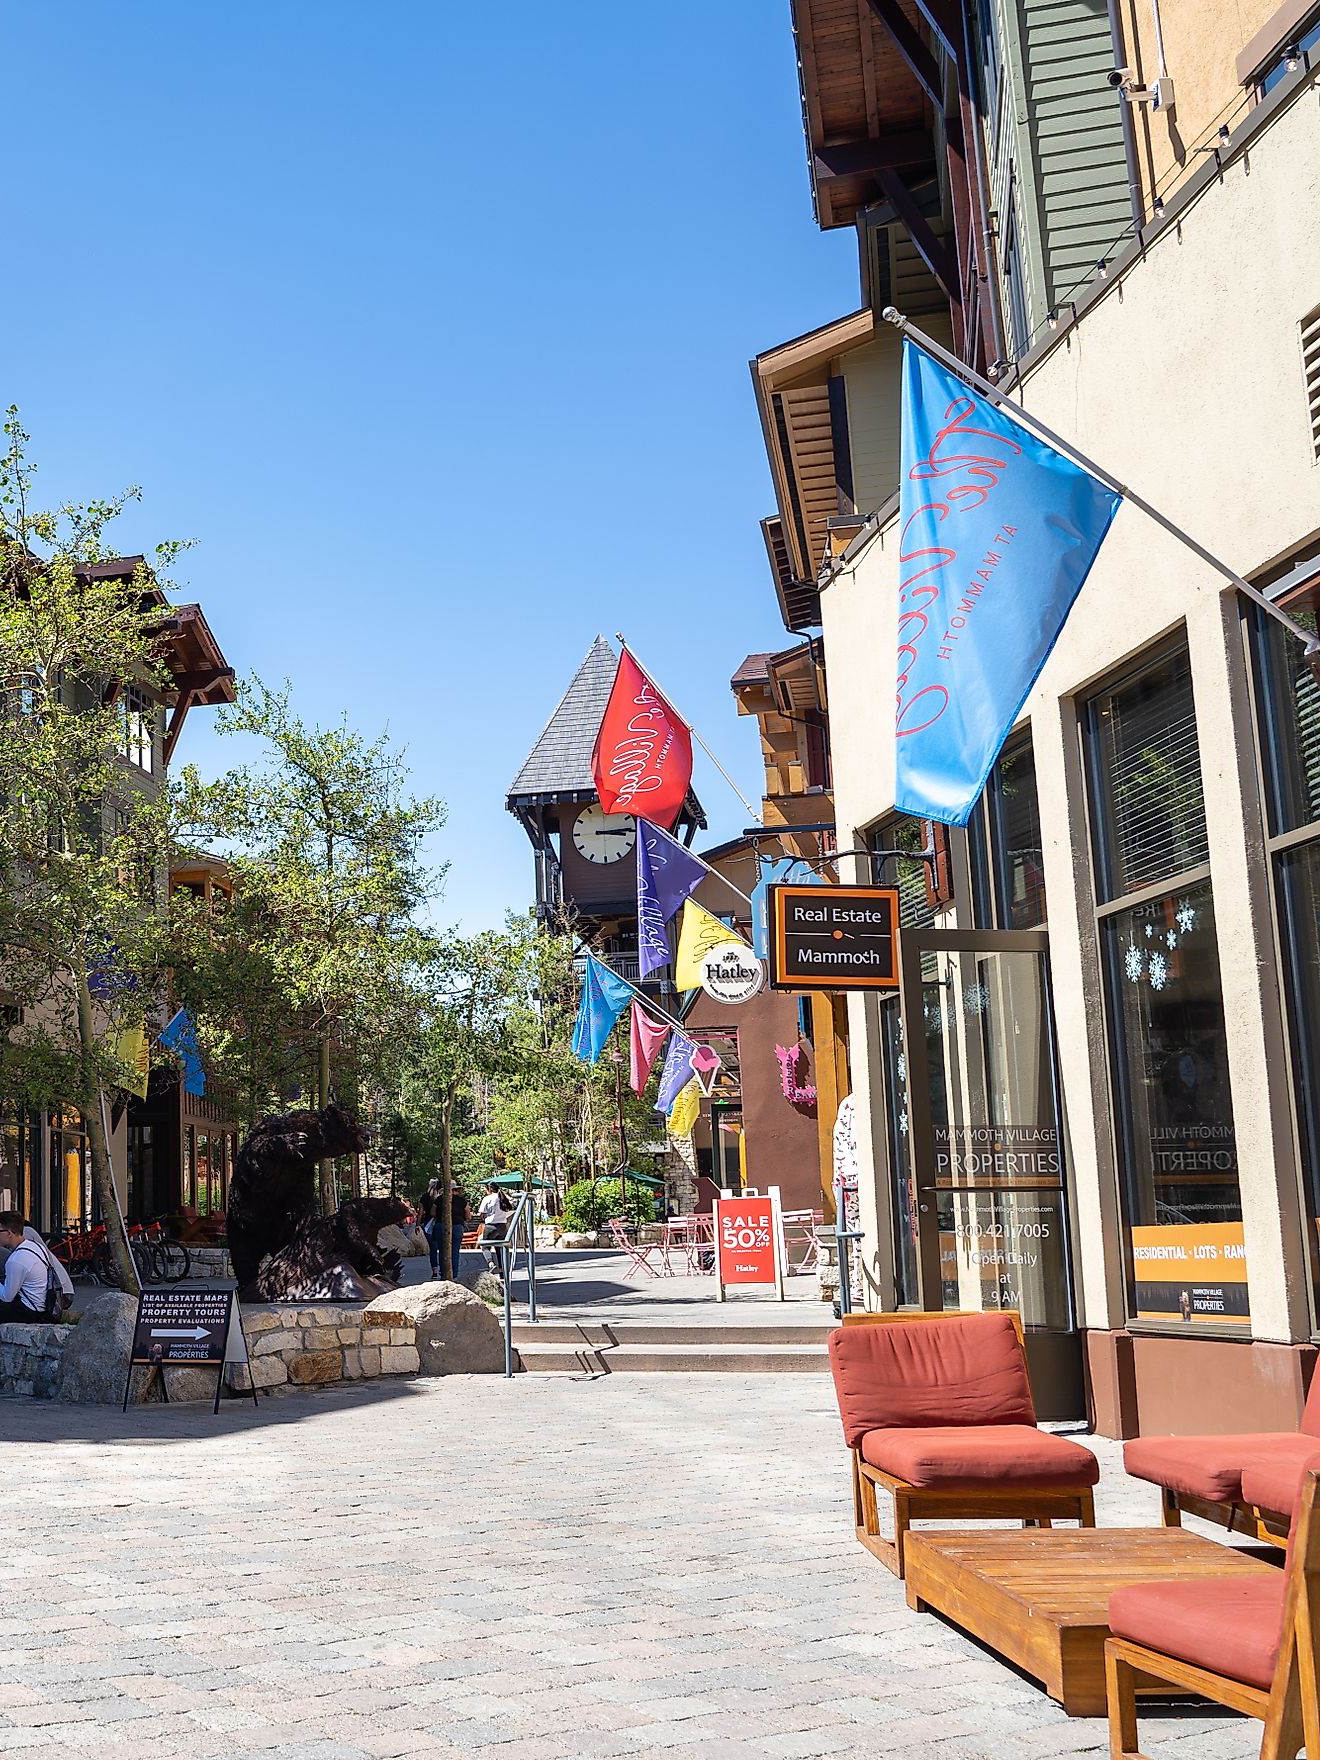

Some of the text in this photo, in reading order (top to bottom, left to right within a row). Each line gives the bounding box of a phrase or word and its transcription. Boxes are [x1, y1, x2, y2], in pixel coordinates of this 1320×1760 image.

[794, 907, 882, 923] Real Estate
[797, 948, 880, 965] Mammoth
[706, 963, 758, 982] Hatley
[935, 1128, 1057, 1142] MAMMOTH VILLAGE
[936, 1153, 1060, 1173] PROPERTIES
[722, 1215, 769, 1228] SALE
[723, 1228, 770, 1249] 50%
[971, 1252, 1005, 1267] Open
[1007, 1251, 1038, 1267] Daily
[1133, 1245, 1188, 1260] RESIDENTIAL
[1193, 1245, 1218, 1259] LOTS
[735, 1264, 759, 1273] Hatley
[999, 1273, 1012, 1284] at
[143, 1294, 166, 1302] REAL
[991, 1290, 1021, 1303] 9 AM
[1193, 1300, 1225, 1311] PROPERTIES
[168, 1350, 209, 1359] PROPERTIES
